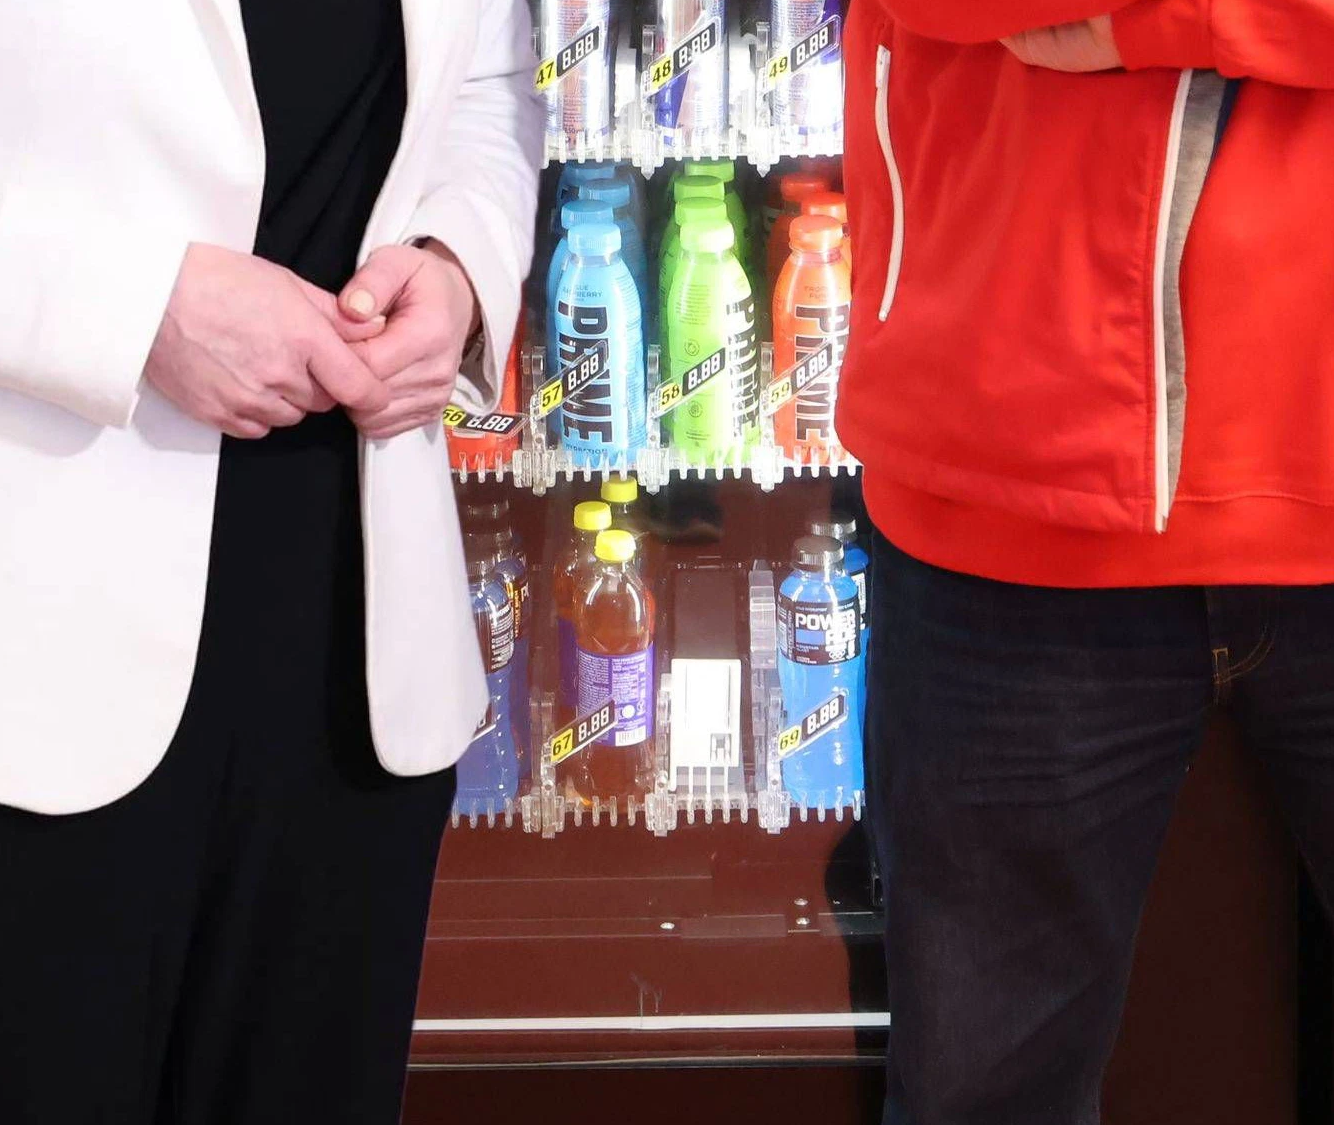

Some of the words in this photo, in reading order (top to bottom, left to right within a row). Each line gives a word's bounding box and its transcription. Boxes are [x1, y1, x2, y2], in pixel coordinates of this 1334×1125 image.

[536, 61, 554, 85] 47
[562, 32, 595, 71] 8.88
[652, 59, 672, 83] 48
[678, 29, 712, 68] 8.88
[768, 55, 789, 79] 49
[796, 26, 829, 66] 8.88
[541, 383, 562, 409] 57
[568, 353, 600, 391] 8.88
[661, 386, 681, 406] 58
[687, 353, 721, 391] 8.88
[770, 380, 790, 404] 59
[796, 349, 829, 389] 8.88
[466, 414, 514, 432] 8.88
[795, 608, 856, 631] POWER
[552, 733, 572, 756] 67
[578, 706, 610, 743] 8.88
[779, 728, 800, 751] 69
[807, 697, 839, 735] 8.88
